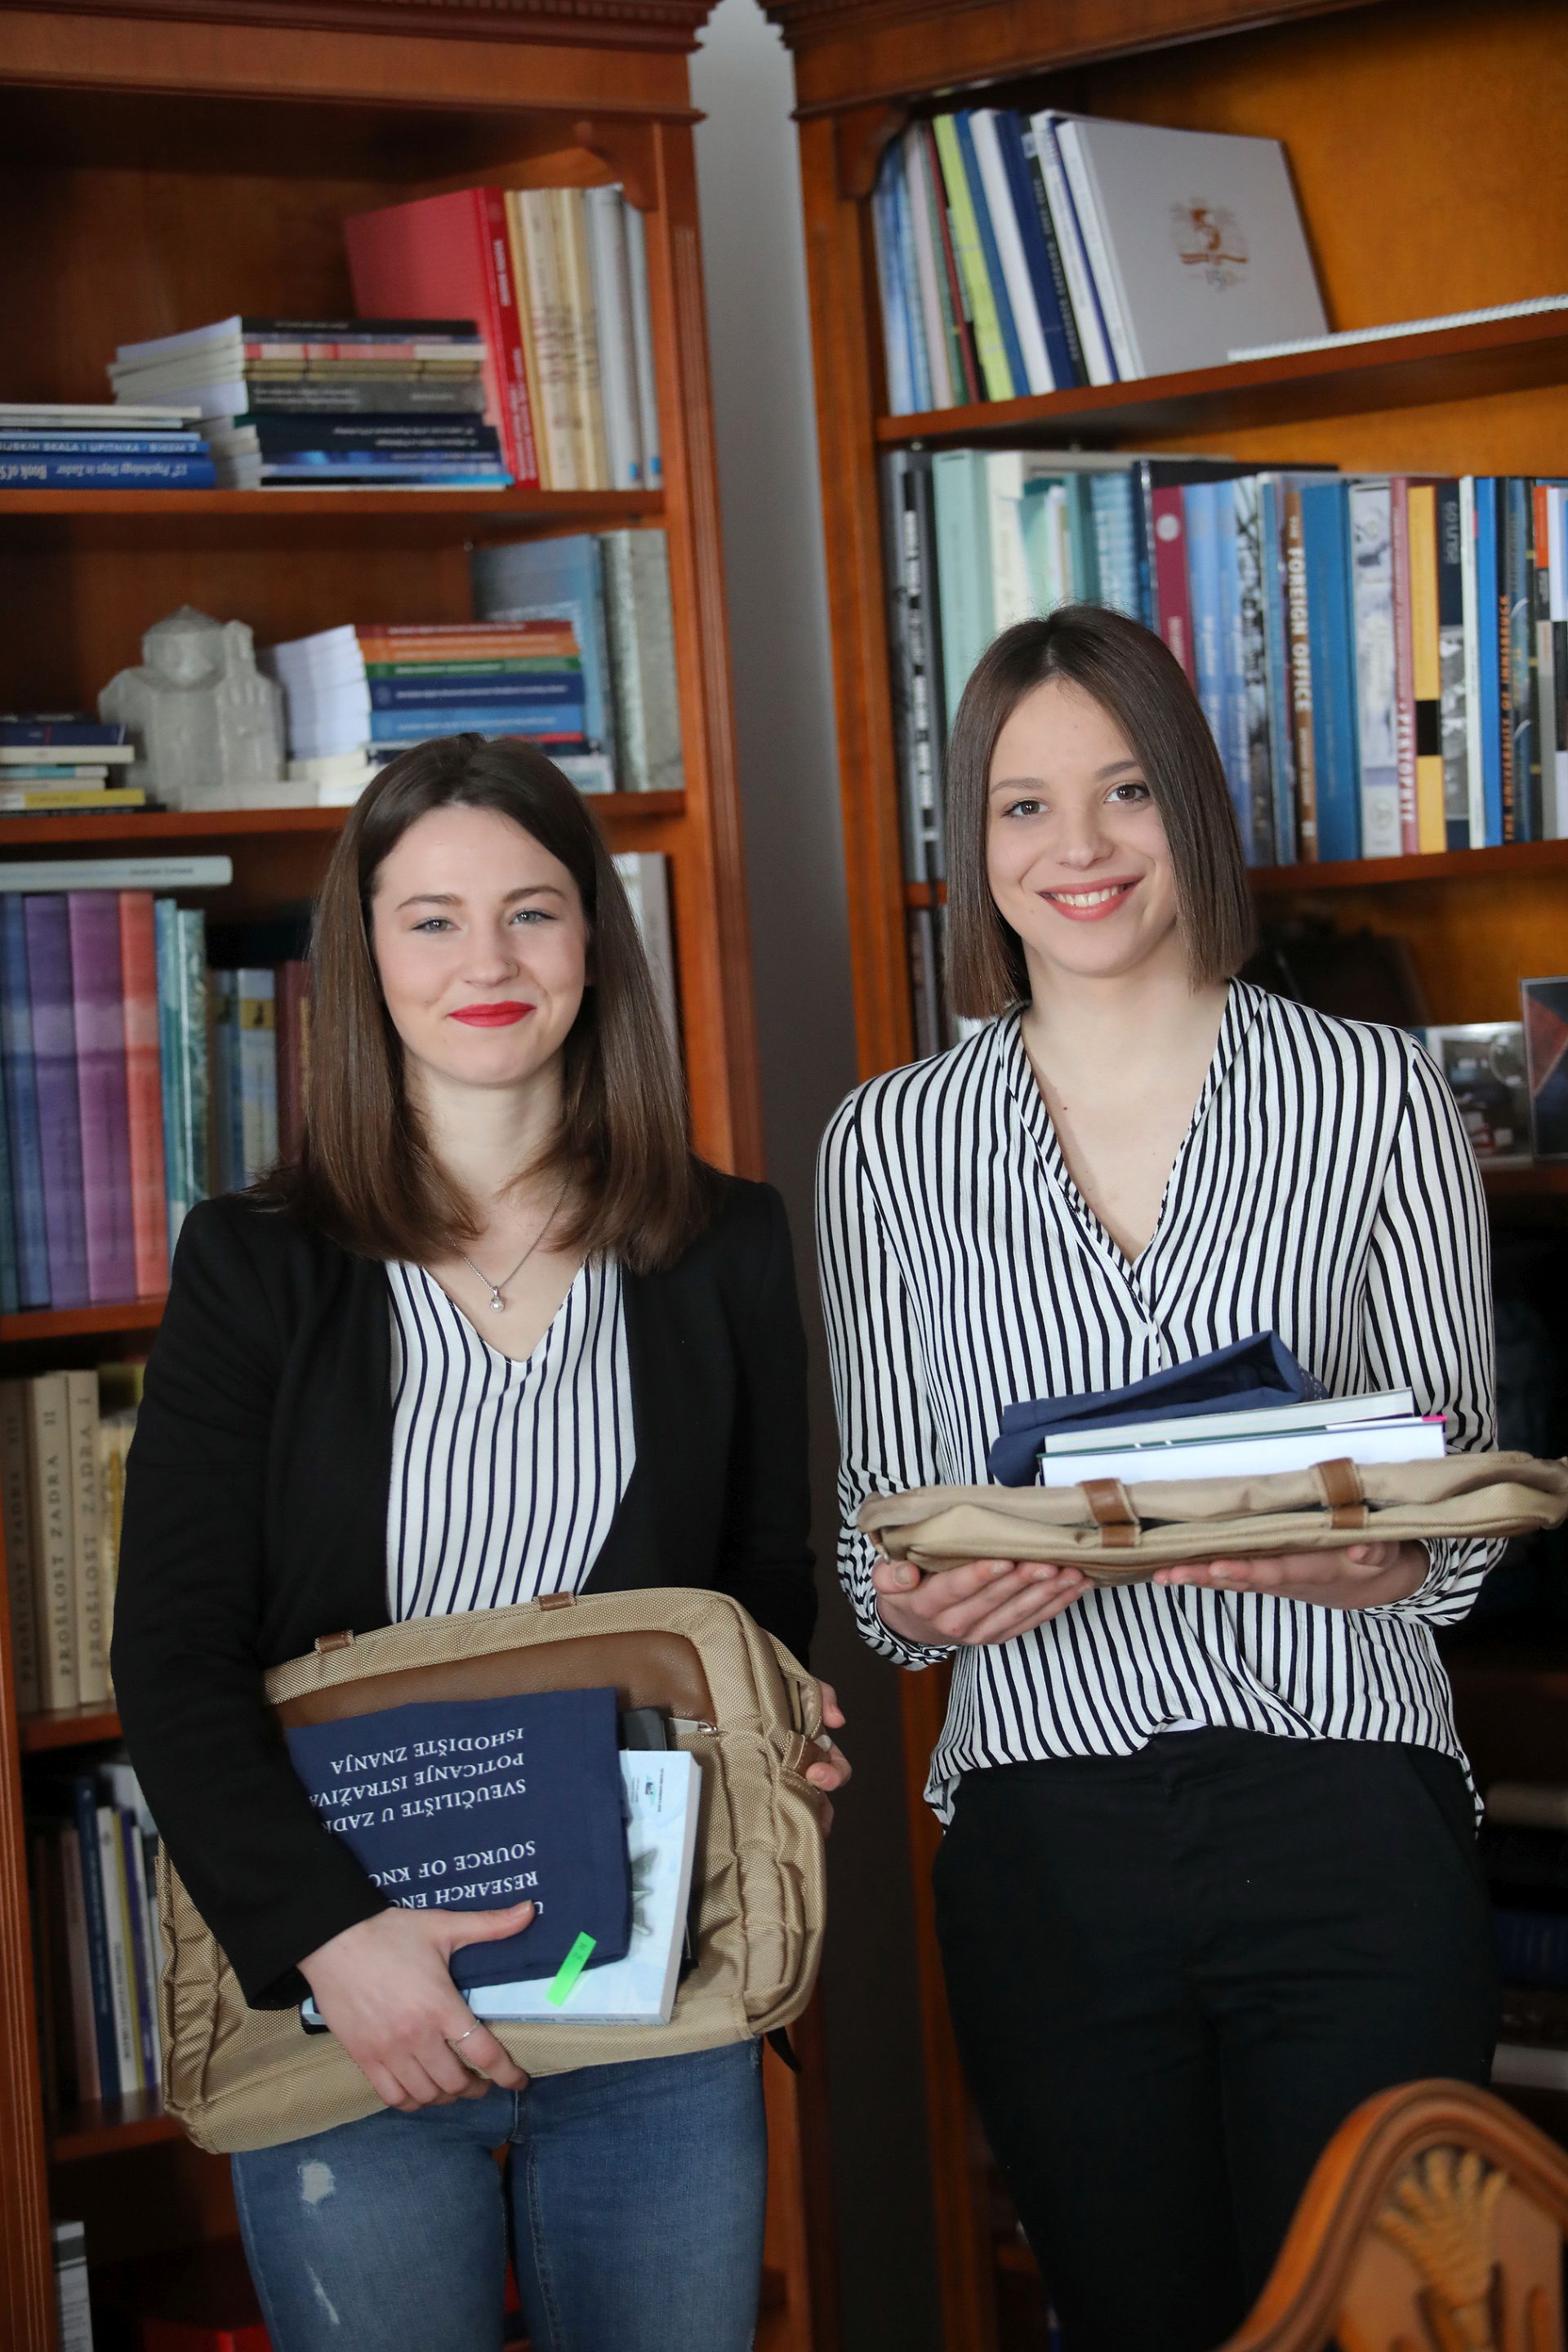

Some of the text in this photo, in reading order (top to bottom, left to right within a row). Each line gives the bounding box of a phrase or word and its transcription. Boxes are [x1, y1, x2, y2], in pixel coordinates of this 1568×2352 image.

[20, 463, 47, 479] Book
[1289, 546, 1307, 635] FOREIGN
[1292, 642, 1313, 714] OFFICE
[1498, 594, 1514, 840] THE UNIVERSITY OF INNSBRUCK
[43, 1410, 56, 1426] II
[78, 1425, 96, 1516] ZADRA
[46, 1455, 62, 1539] ZADRA
[330, 1727, 523, 1775] ISHODIŠTE ZNANJA
[414, 1753, 524, 1786] POTICANJE
[381, 1807, 394, 1823] U
[400, 1779, 527, 1817] SVEUČILIŠTE
[418, 1860, 447, 1878] OF
[453, 1840, 536, 1871] SOURCE
[434, 1871, 539, 1904] RESEARCH
